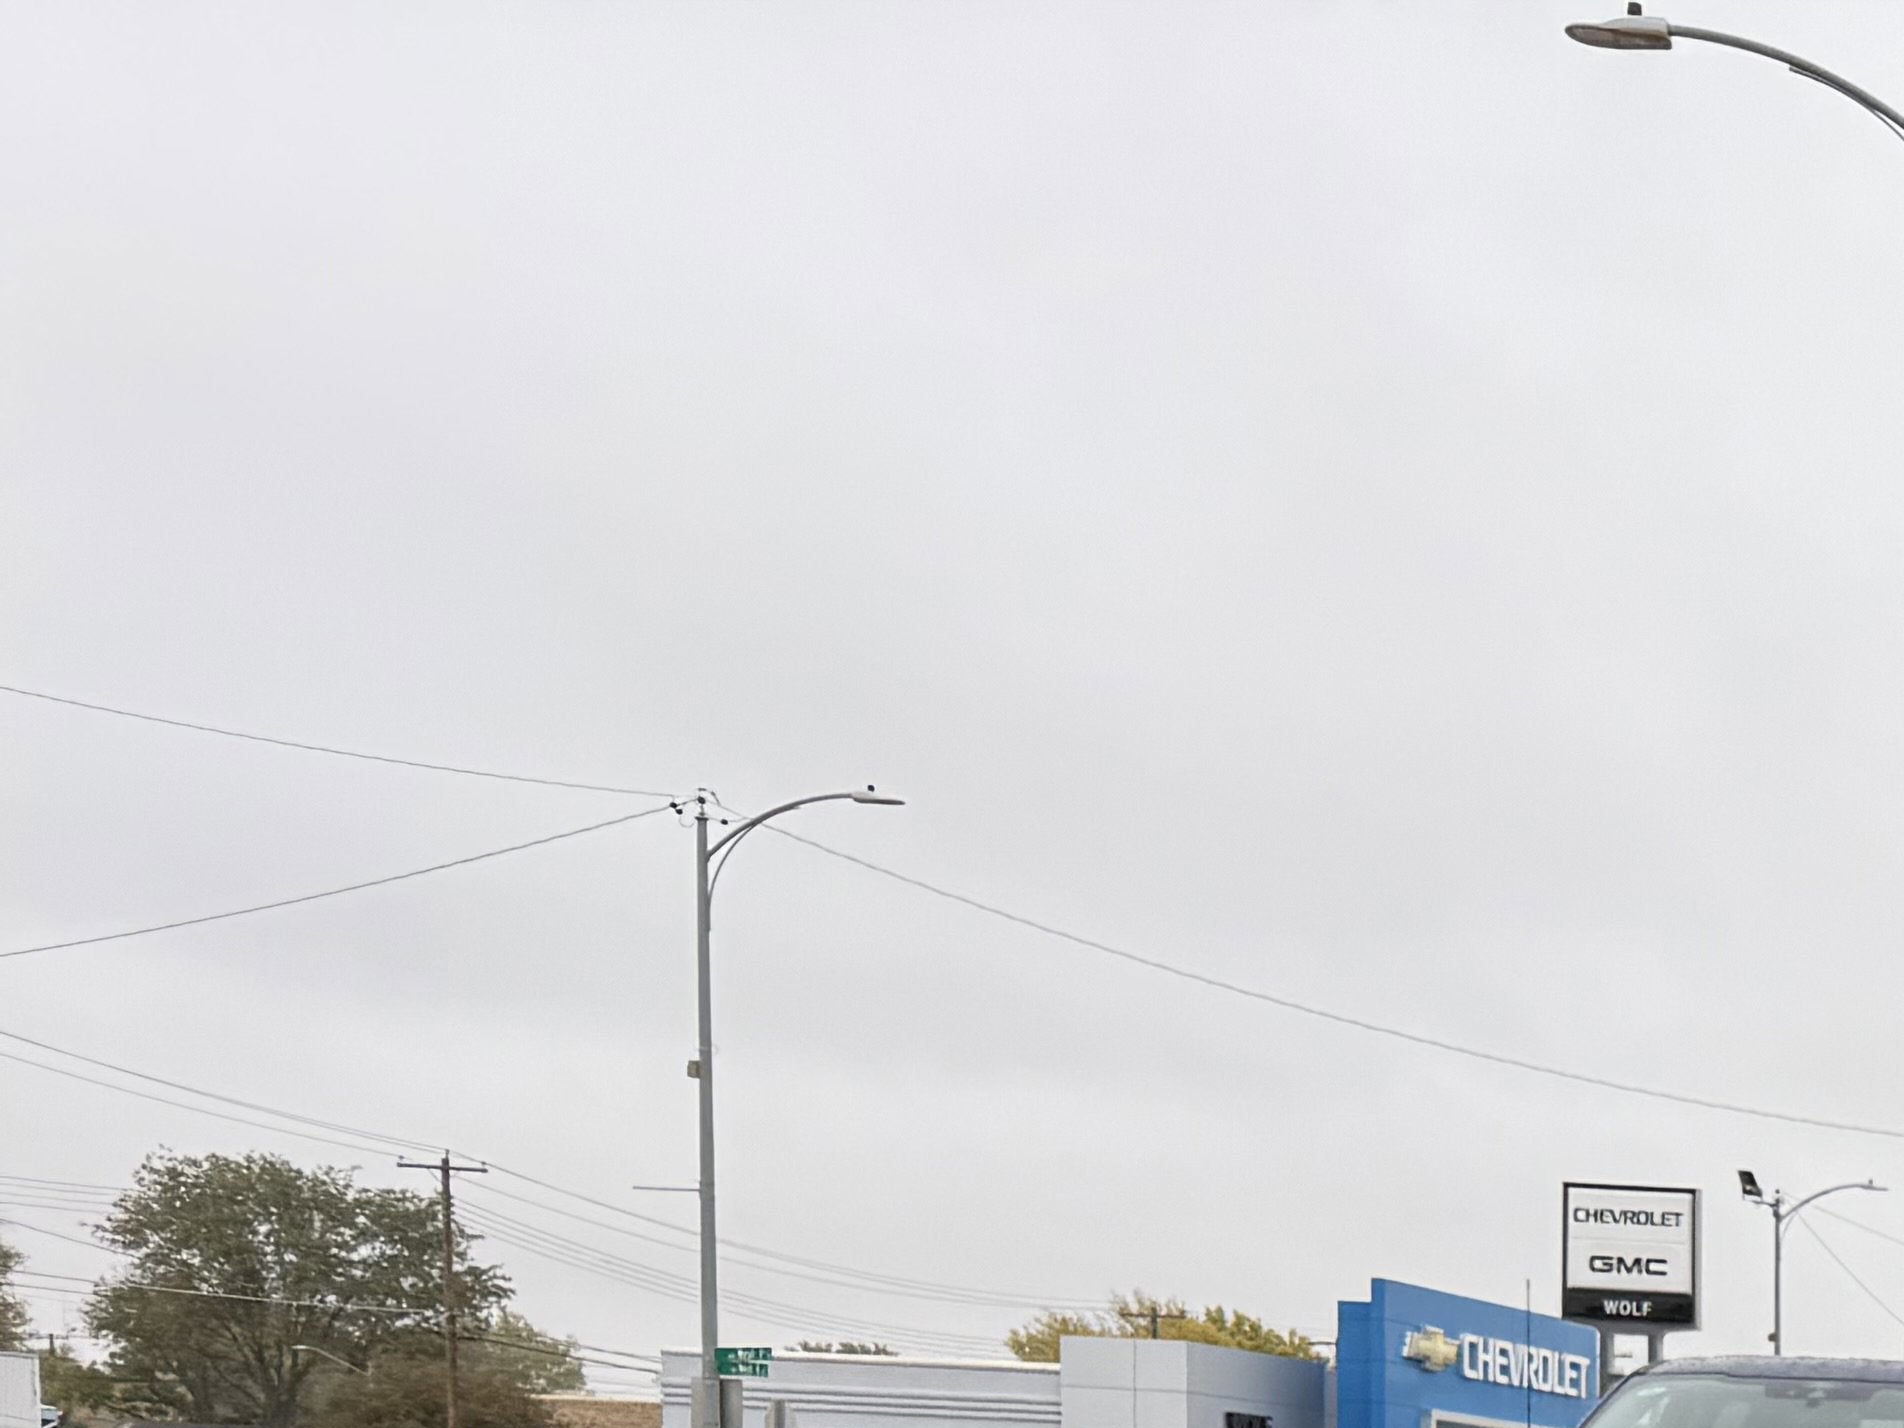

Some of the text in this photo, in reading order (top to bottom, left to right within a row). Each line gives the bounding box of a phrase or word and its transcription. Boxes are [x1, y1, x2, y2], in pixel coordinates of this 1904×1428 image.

[1573, 1208, 1684, 1228] CHEVROLET
[1589, 1255, 1668, 1276] GMC
[1603, 1300, 1652, 1317] WOLF
[1460, 1332, 1590, 1399] CHEVROLET
